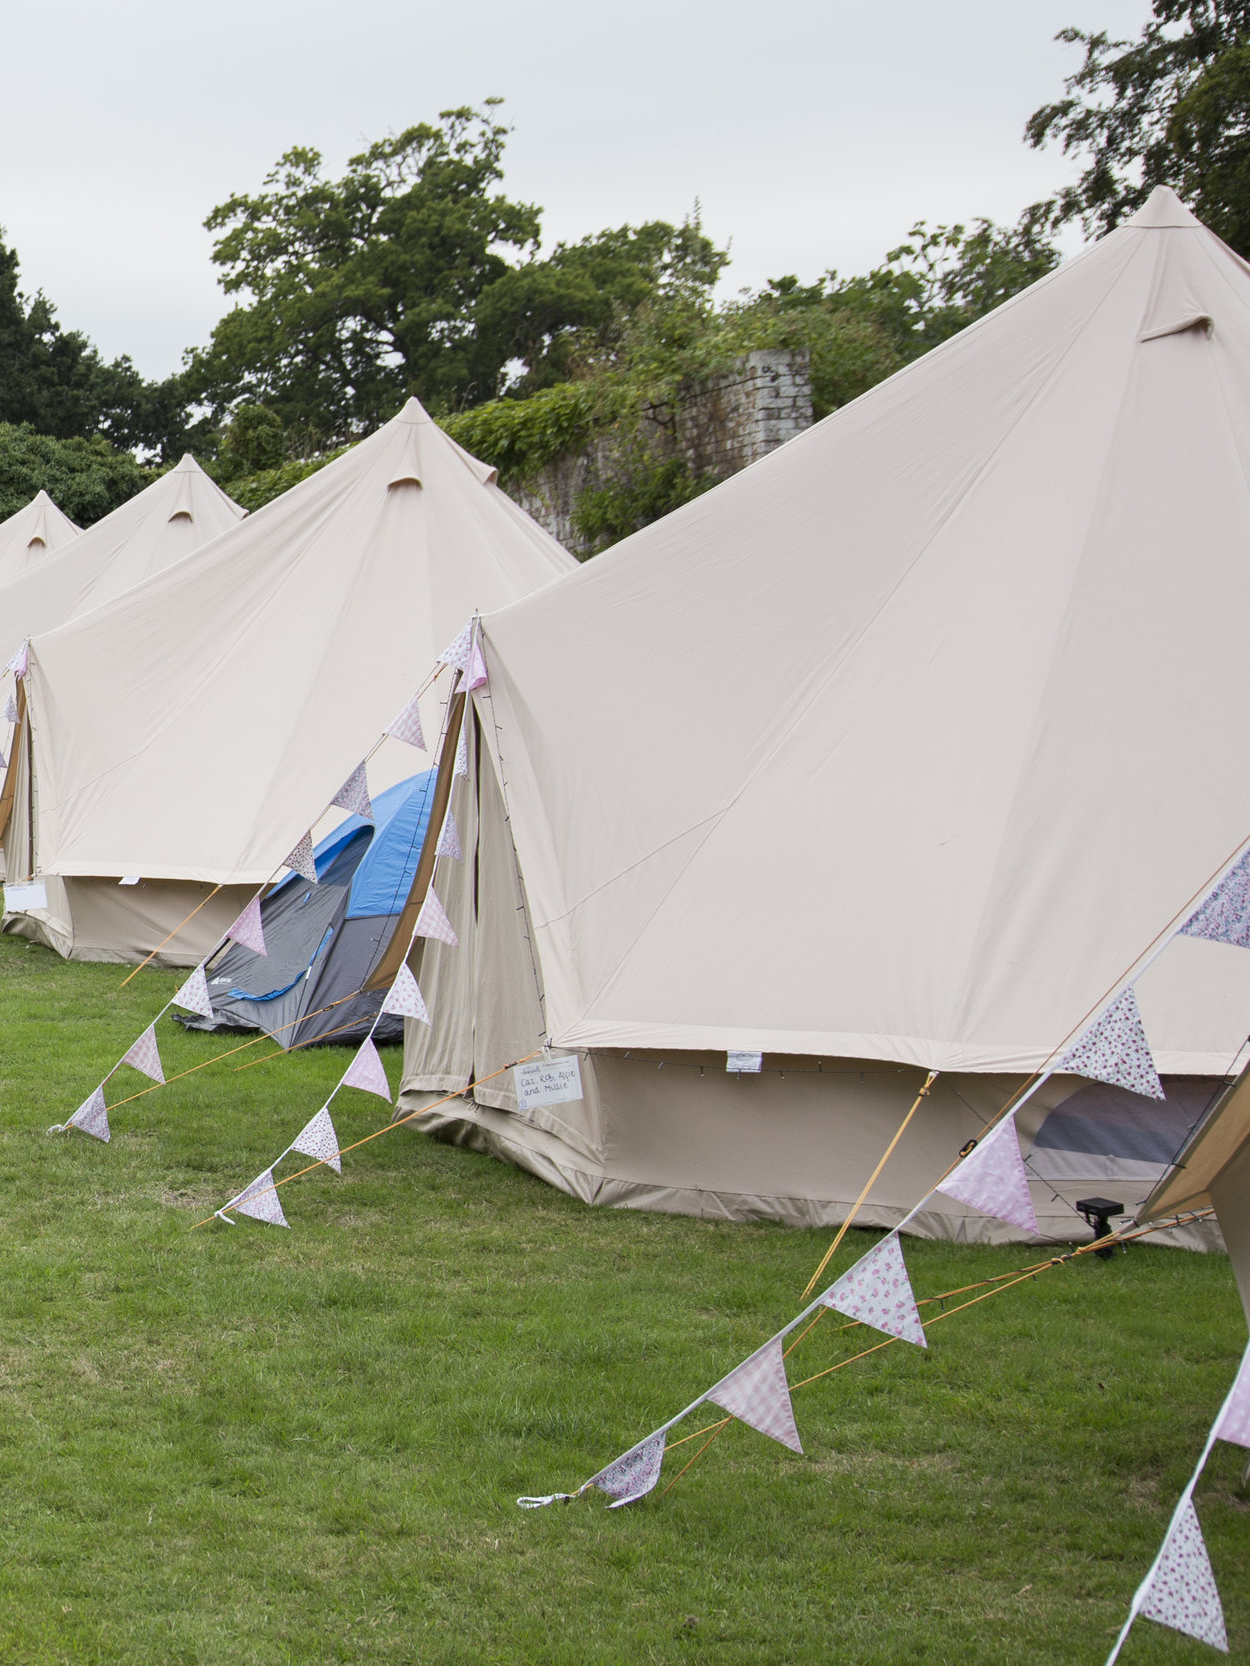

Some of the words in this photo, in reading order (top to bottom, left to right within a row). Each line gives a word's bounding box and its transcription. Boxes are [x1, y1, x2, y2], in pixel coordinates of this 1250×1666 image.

[558, 1070, 575, 1081] Alfie
[525, 1086, 541, 1096] and
[544, 1082, 568, 1092] Millie
